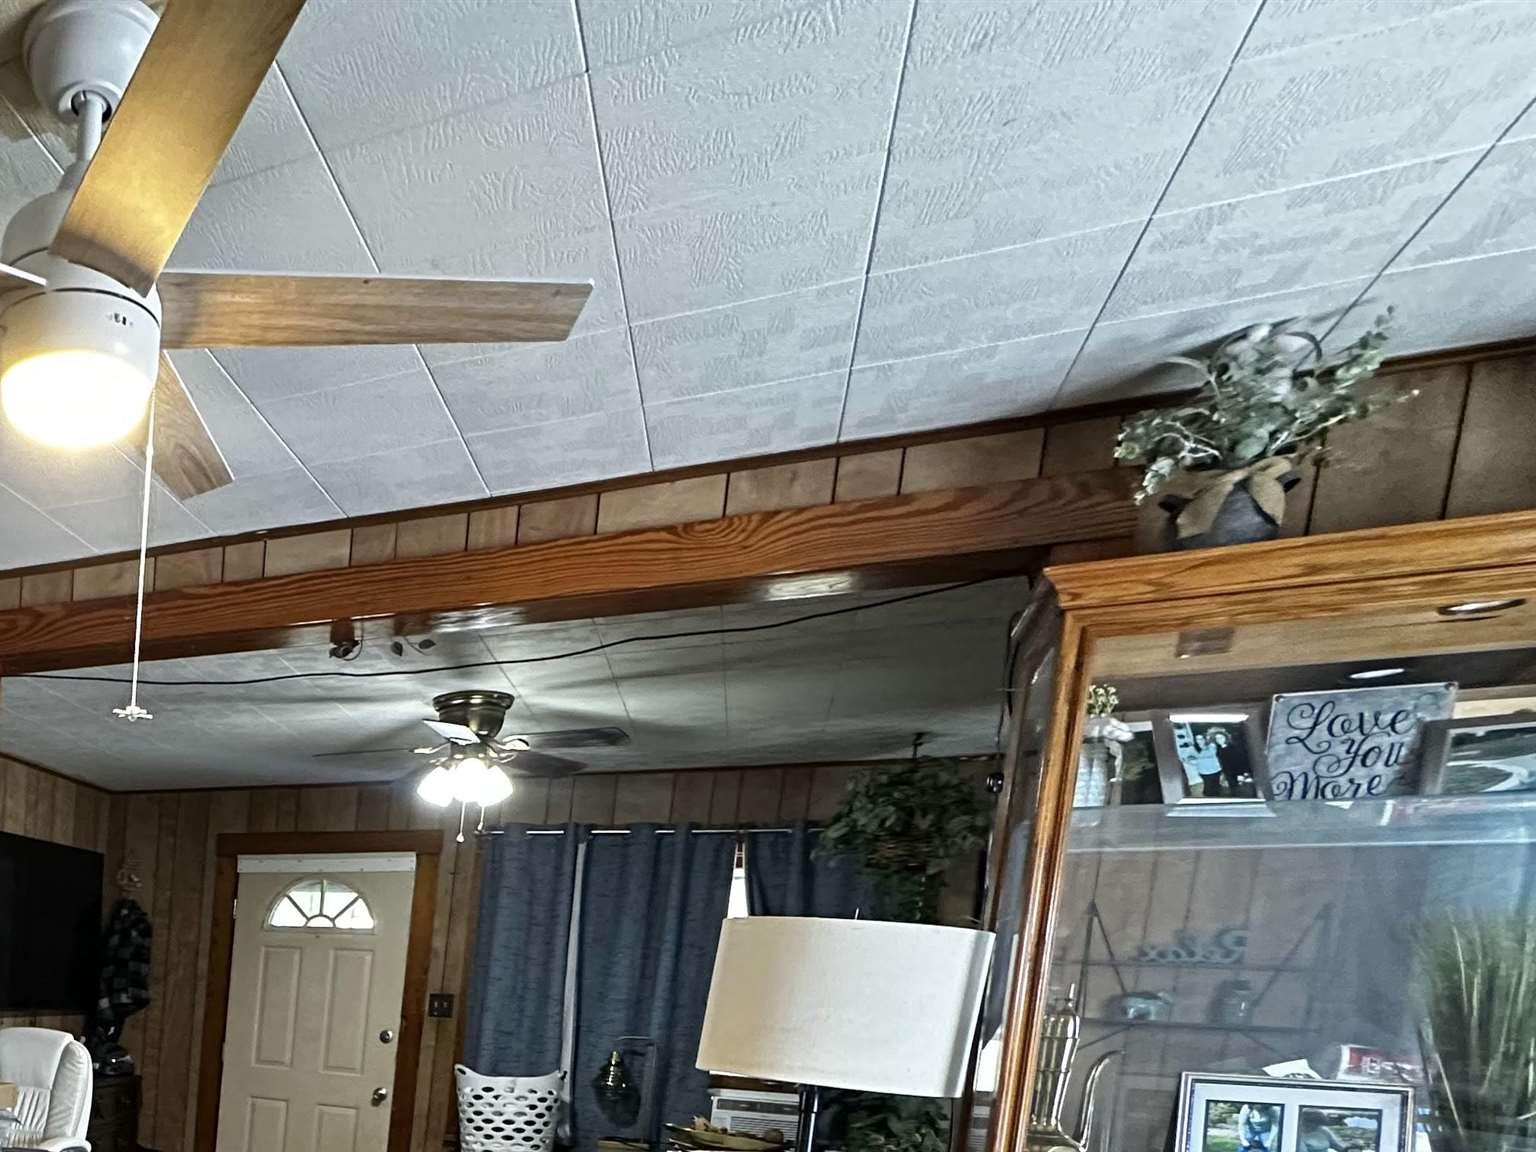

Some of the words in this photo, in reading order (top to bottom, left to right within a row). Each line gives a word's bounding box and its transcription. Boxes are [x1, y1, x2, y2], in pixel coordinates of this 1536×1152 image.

[1285, 700, 1414, 755] Love
[1312, 732, 1405, 779] You
[1270, 770, 1384, 801] More
